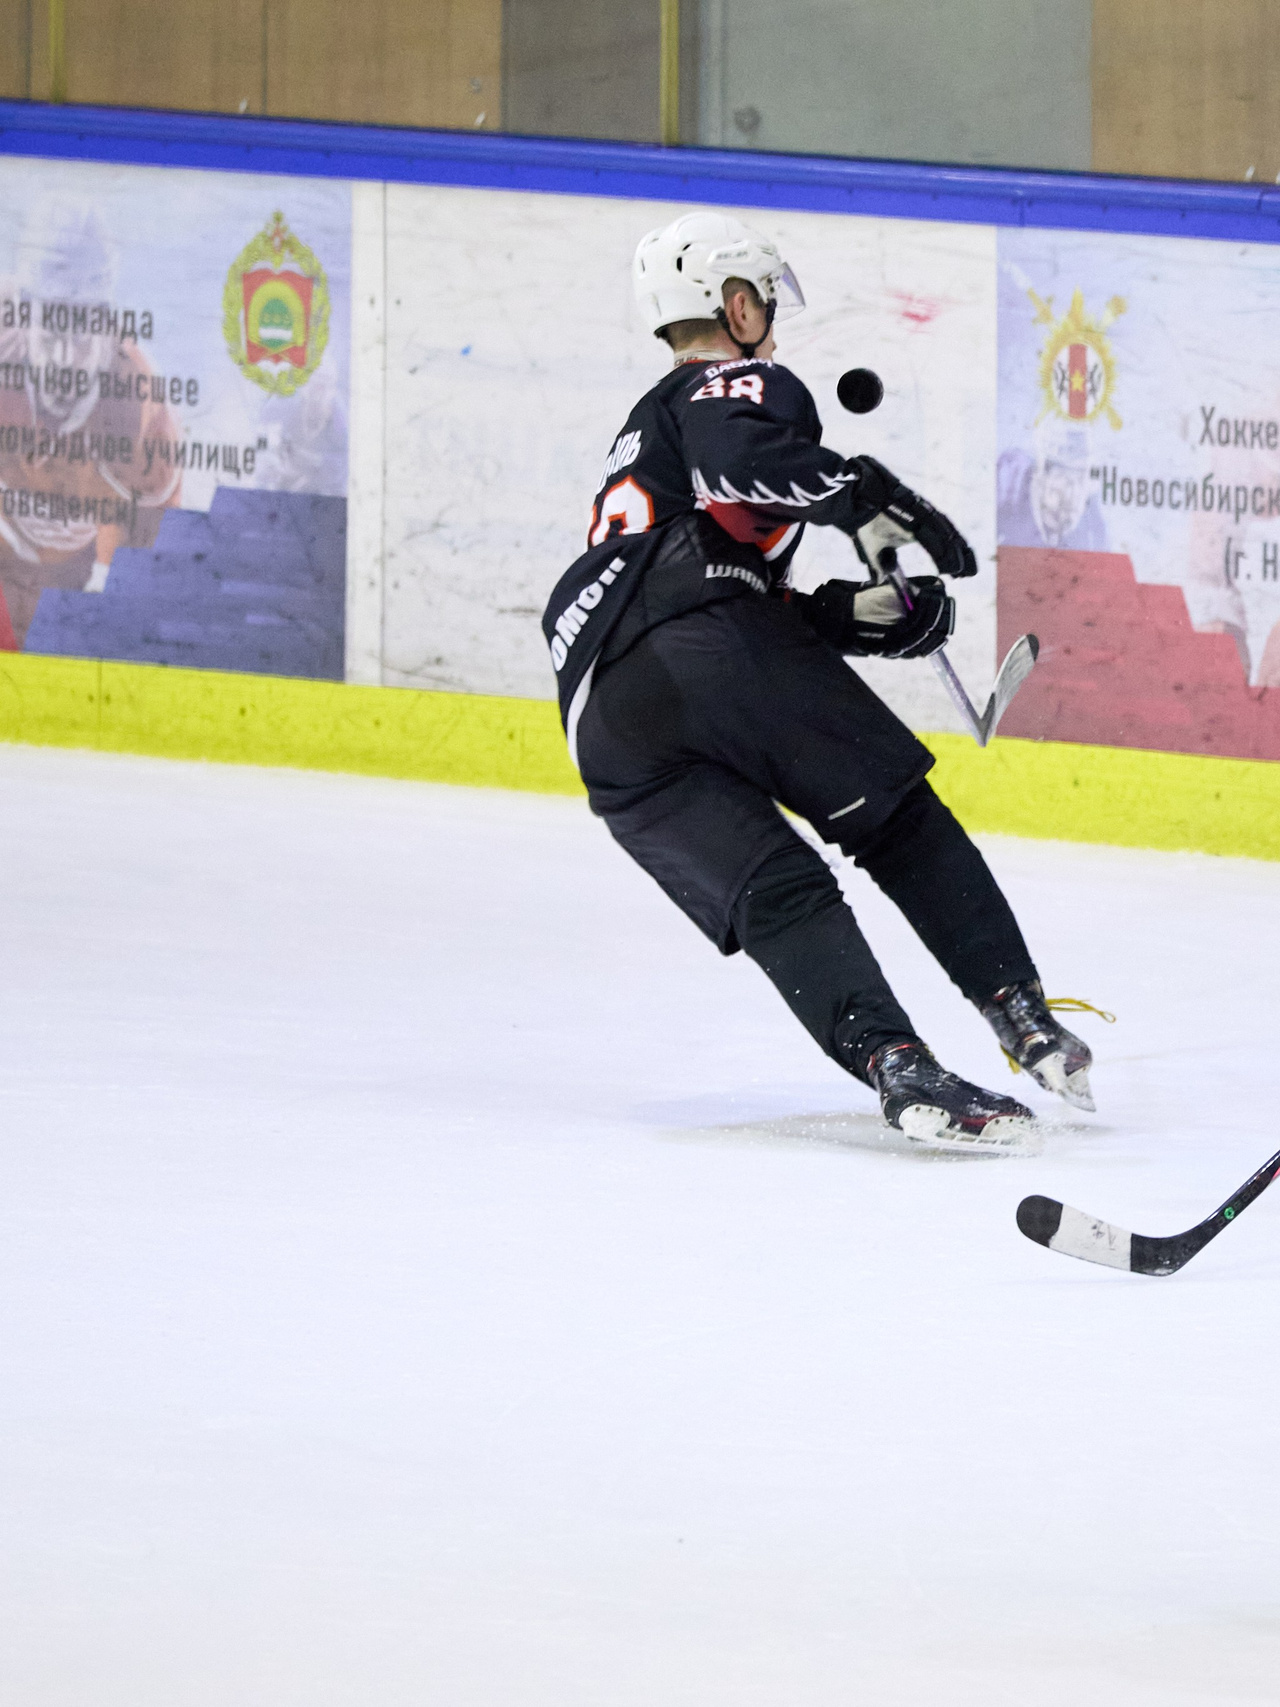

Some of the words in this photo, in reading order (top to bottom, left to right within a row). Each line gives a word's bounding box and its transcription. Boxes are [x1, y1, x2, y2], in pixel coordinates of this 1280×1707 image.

[42, 303, 154, 346] команда
[100, 371, 199, 406] высшее
[0, 425, 133, 464] омандное
[0, 484, 138, 533] овещенск)
